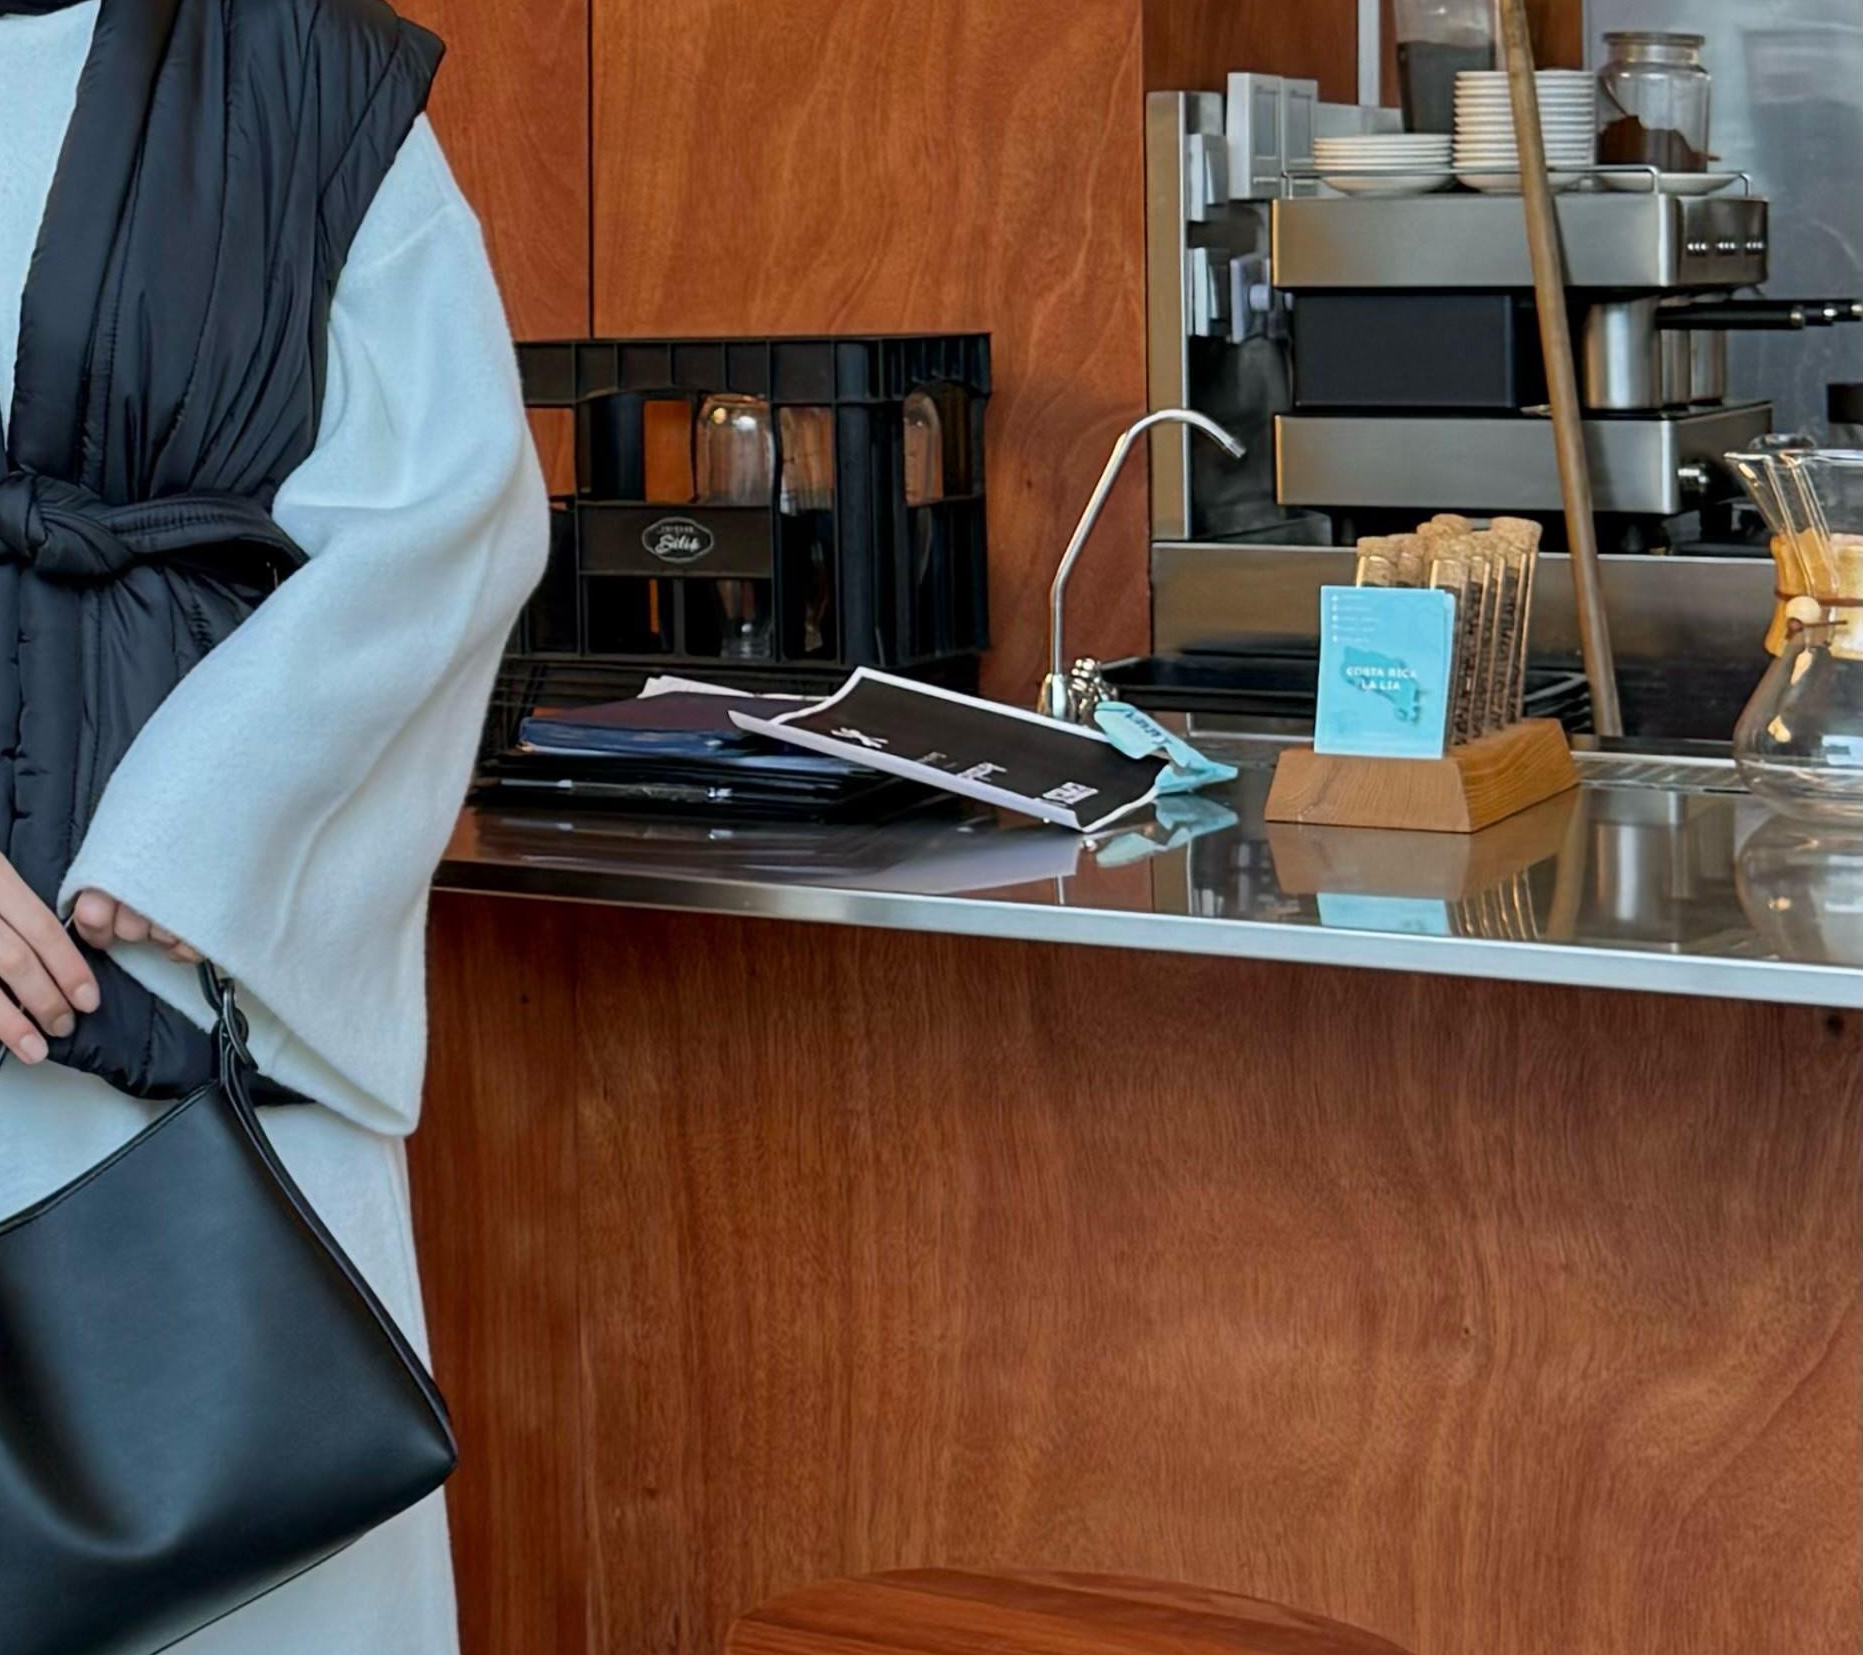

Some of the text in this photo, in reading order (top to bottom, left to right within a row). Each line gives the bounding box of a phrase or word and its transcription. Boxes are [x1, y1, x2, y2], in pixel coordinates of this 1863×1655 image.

[1345, 666, 1418, 679] COSTA RICA
[1361, 680, 1377, 691] LA
